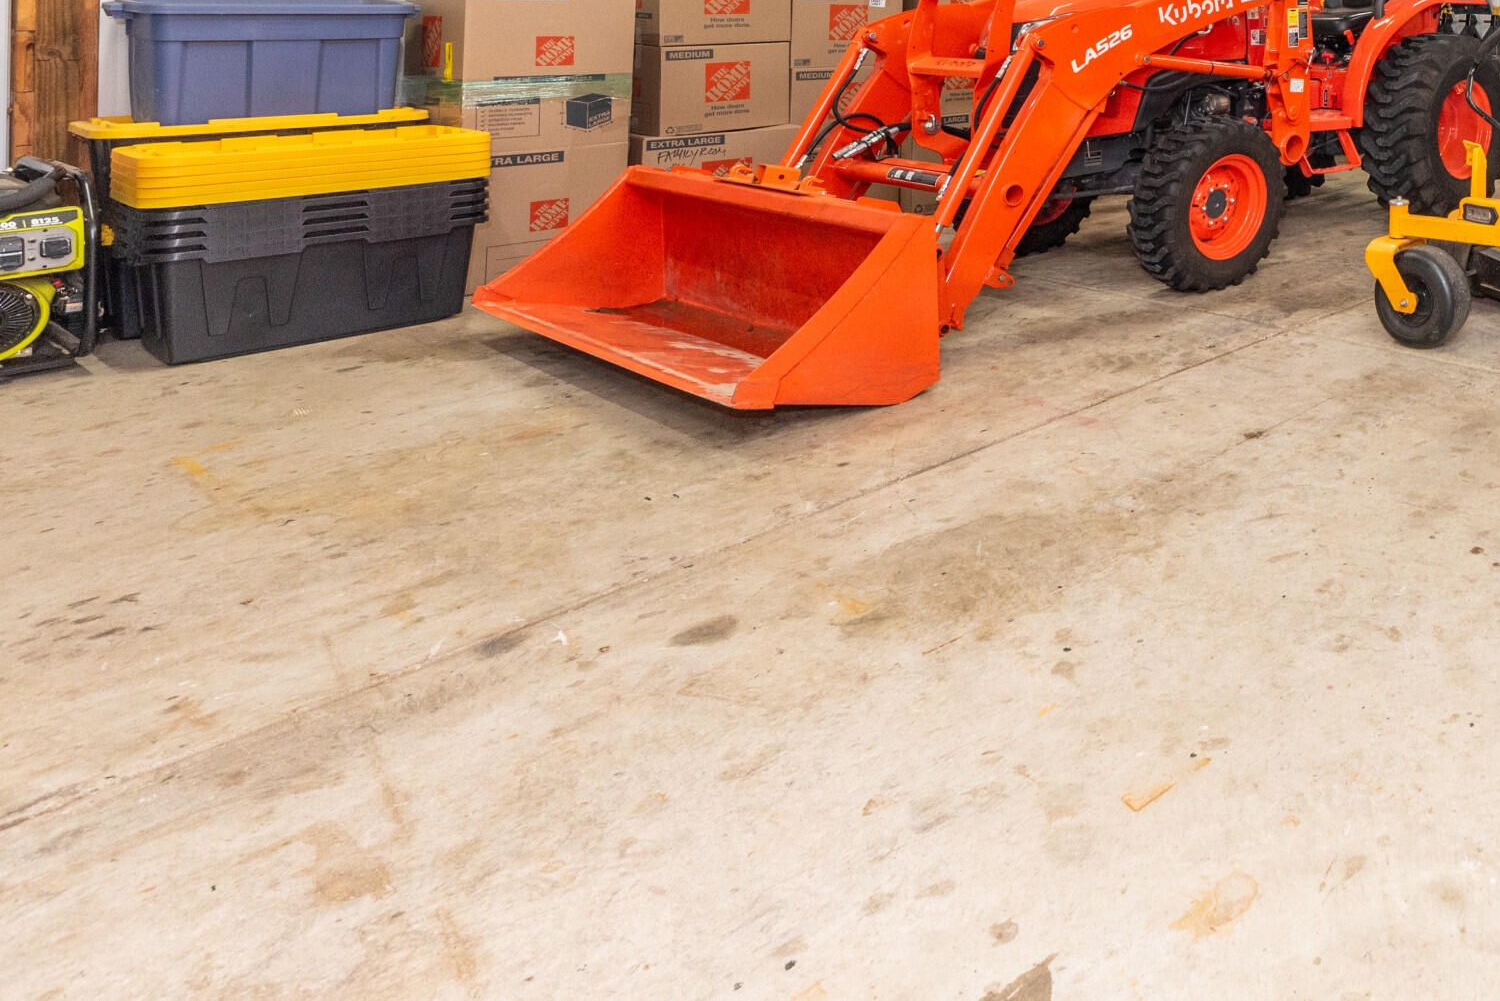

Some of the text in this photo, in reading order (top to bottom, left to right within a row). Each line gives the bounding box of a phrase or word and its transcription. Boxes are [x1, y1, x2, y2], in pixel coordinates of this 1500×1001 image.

[535, 35, 575, 67] HOME
[669, 50, 711, 60] MEDIUM
[1070, 23, 1133, 74] LA526
[705, 61, 750, 102] HOME
[943, 115, 967, 124] LARGE
[650, 136, 721, 149] EXTRA LARGE
[516, 152, 560, 165] LARGE
[31, 217, 61, 226] 8125
[529, 199, 570, 232] HOME
